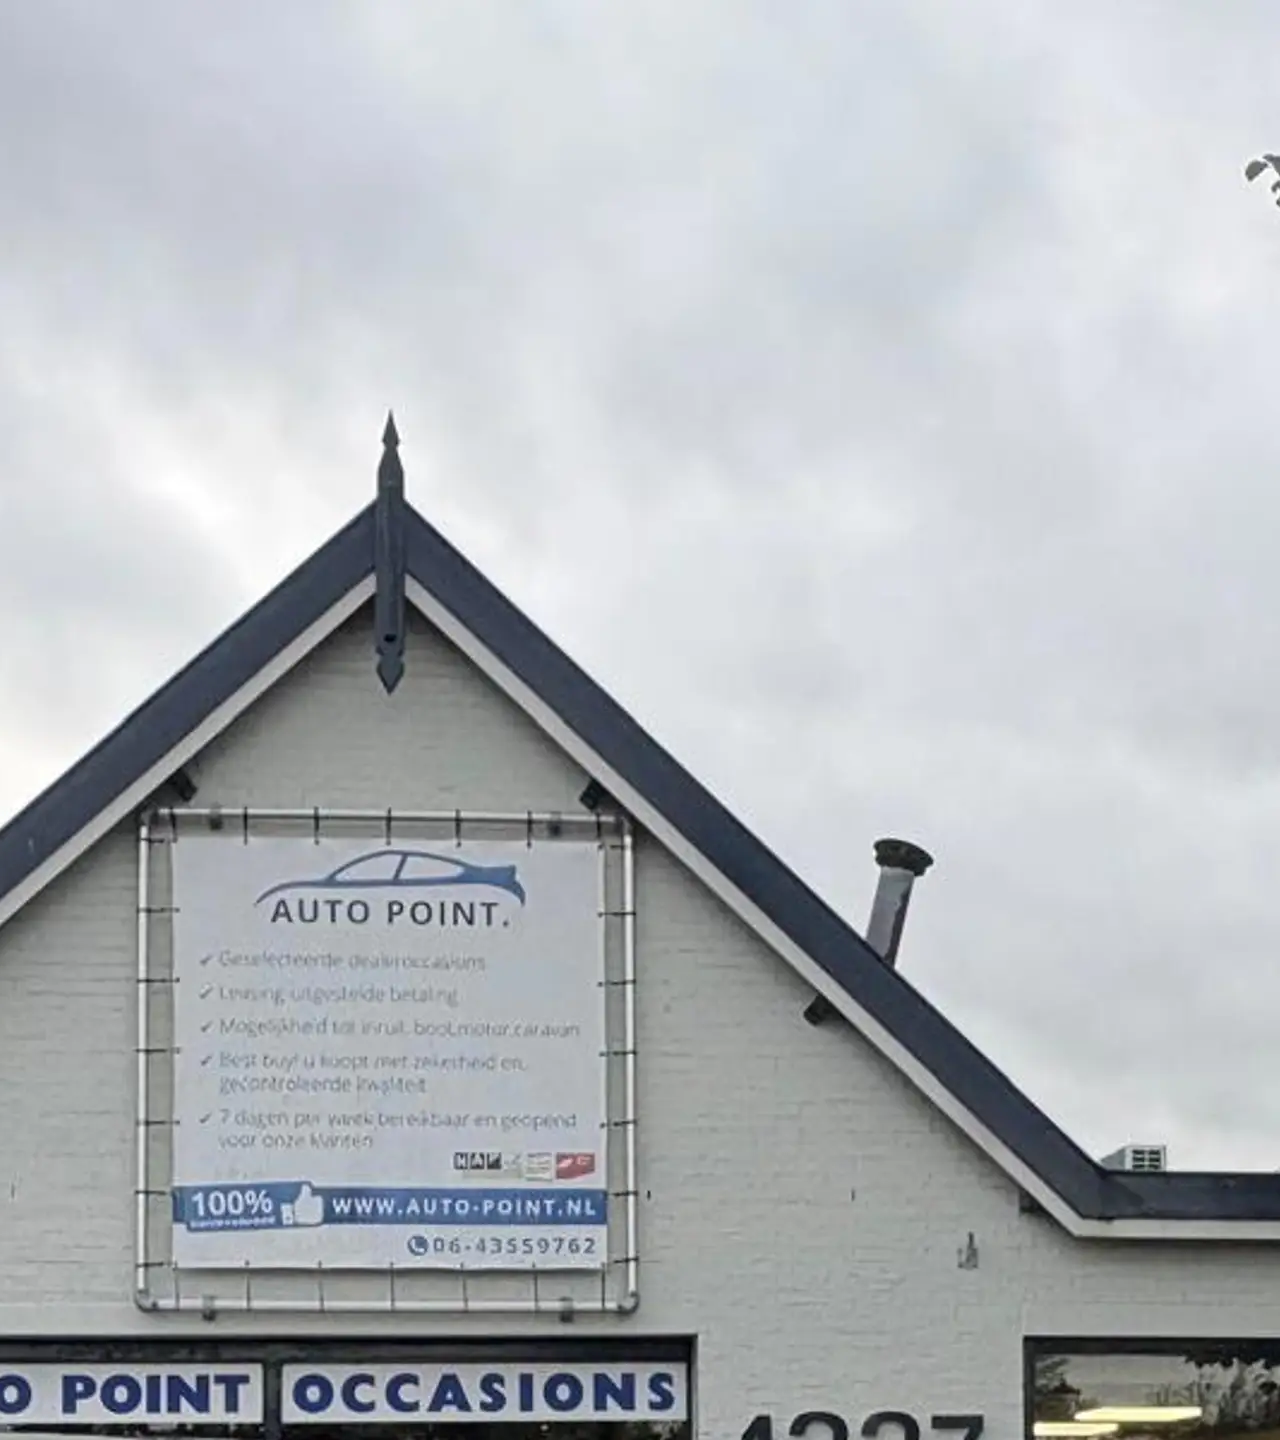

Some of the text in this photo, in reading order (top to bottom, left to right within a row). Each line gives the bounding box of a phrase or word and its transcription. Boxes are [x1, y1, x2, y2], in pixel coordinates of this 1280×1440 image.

[270, 899, 369, 924] AUTO
[220, 1110, 230, 1127] 7
[191, 1189, 274, 1217] 100%
[332, 1197, 597, 1217] WWW.AUTO-POINT.NL
[433, 1236, 597, 1256] 06-43559762
[62, 1372, 250, 1415] POINT
[293, 1372, 676, 1412] OCCASIONS
